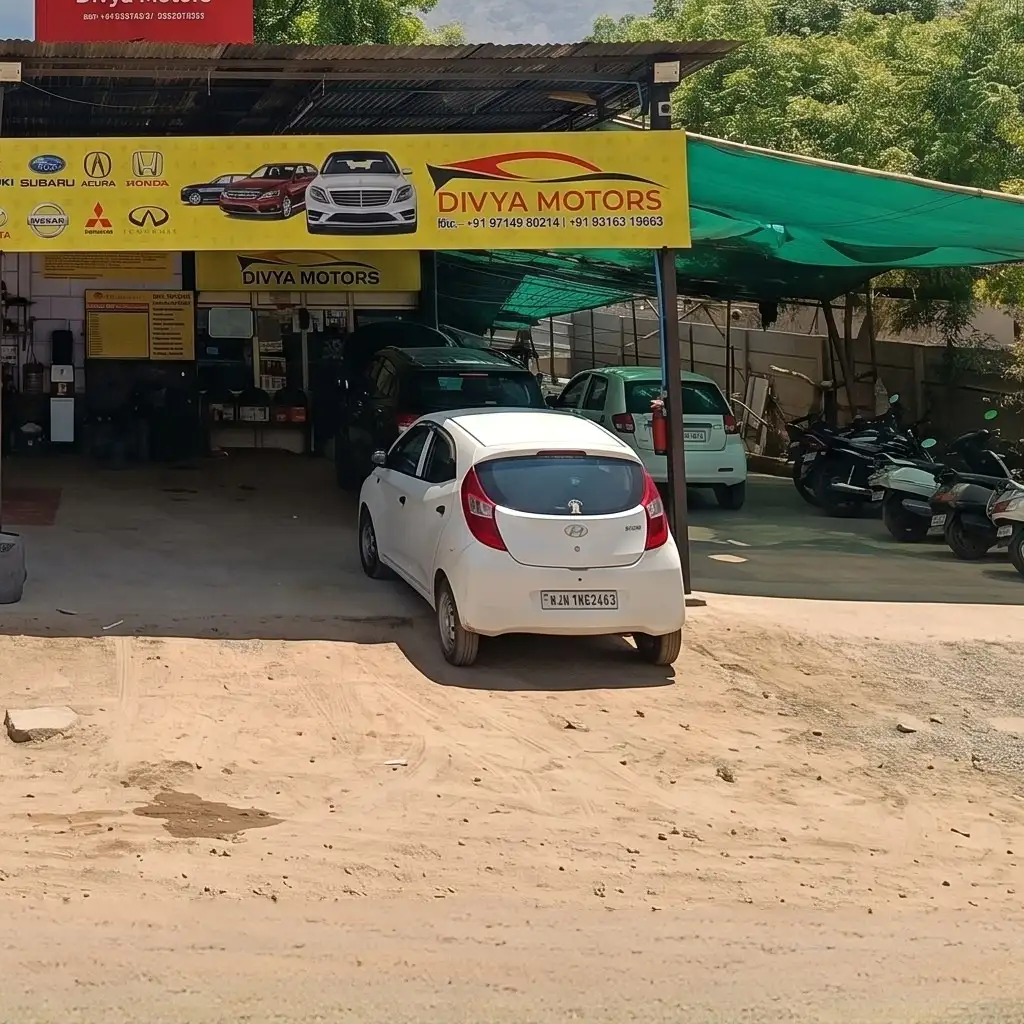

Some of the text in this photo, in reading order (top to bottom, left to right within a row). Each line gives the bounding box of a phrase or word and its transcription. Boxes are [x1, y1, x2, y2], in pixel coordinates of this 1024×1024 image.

[20, 178, 75, 187] SUBARU
[438, 189, 663, 213] DIVYA MOTORS
[467, 218, 486, 228] +91
[489, 218, 523, 228] 97149
[526, 217, 560, 228] 80214
[570, 217, 589, 227] +91
[592, 217, 626, 227] 93163
[629, 216, 664, 226] 19663
[242, 270, 380, 285] DIVYA MOTORS
